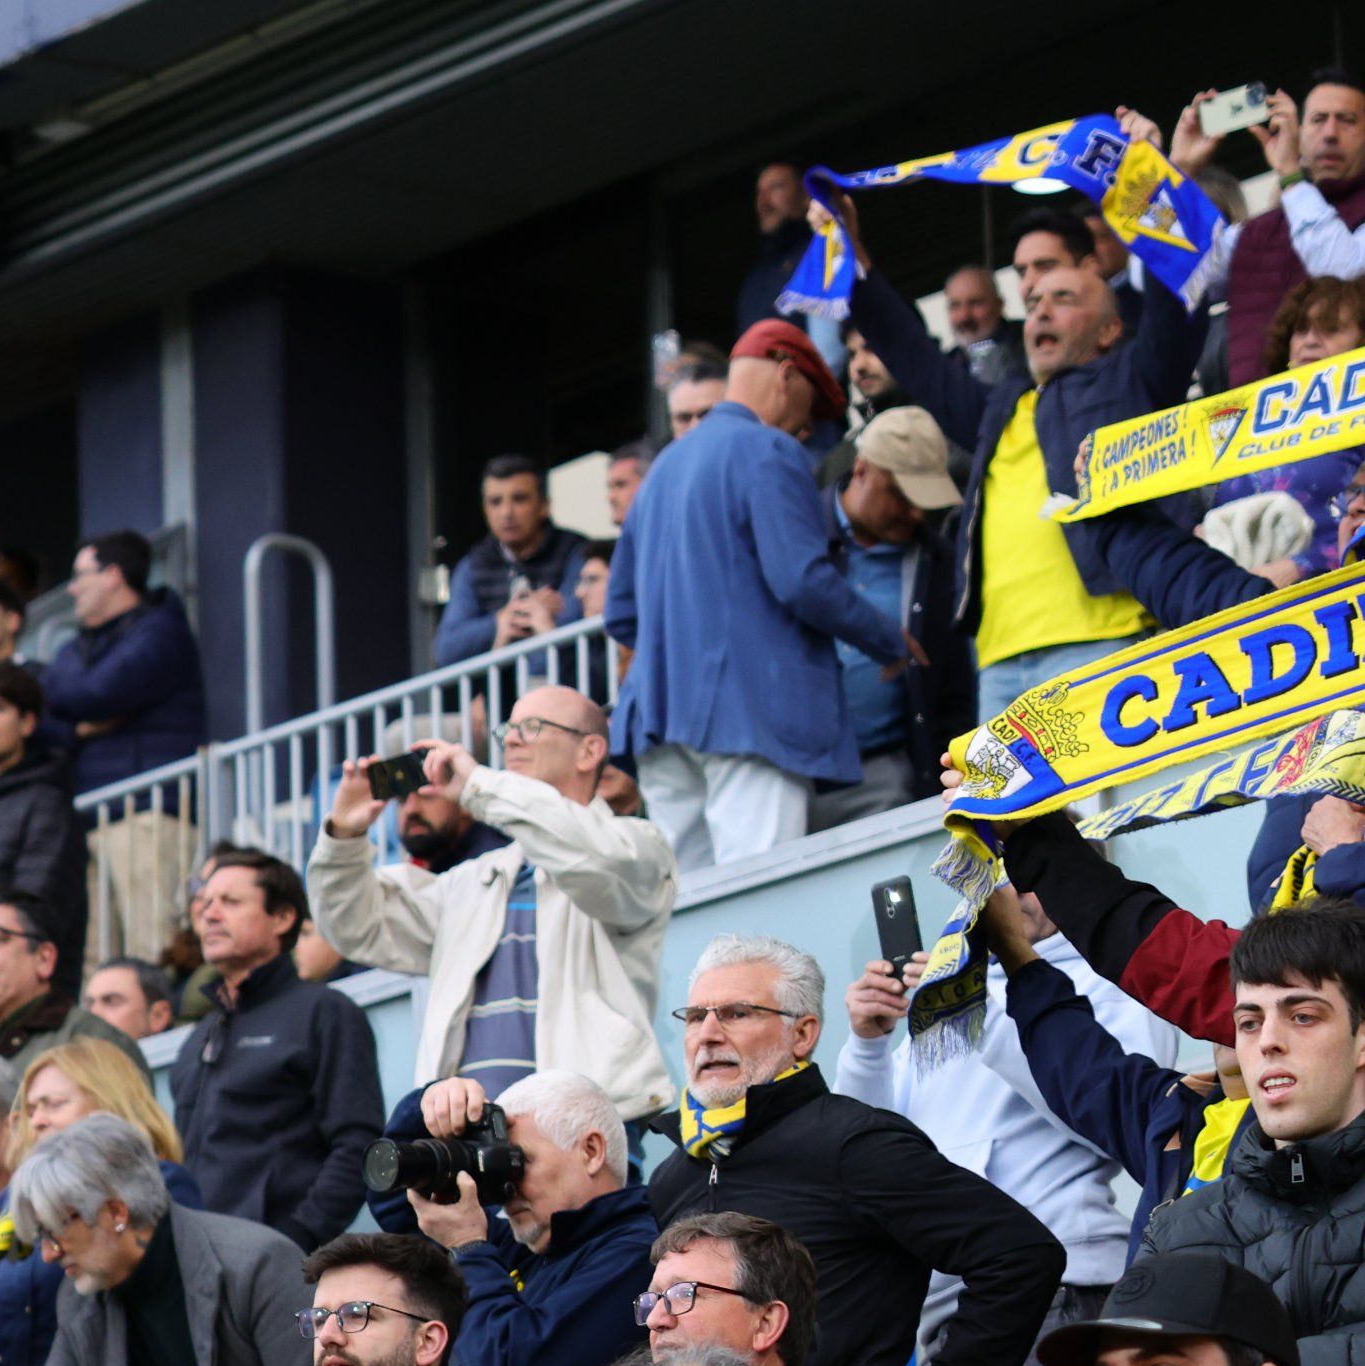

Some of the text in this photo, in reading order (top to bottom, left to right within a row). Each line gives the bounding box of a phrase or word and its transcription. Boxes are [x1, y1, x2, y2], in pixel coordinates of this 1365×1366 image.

[1237, 432, 1302, 460] CLUB
[1309, 420, 1342, 441] DE
[1100, 591, 1365, 749] CADI
